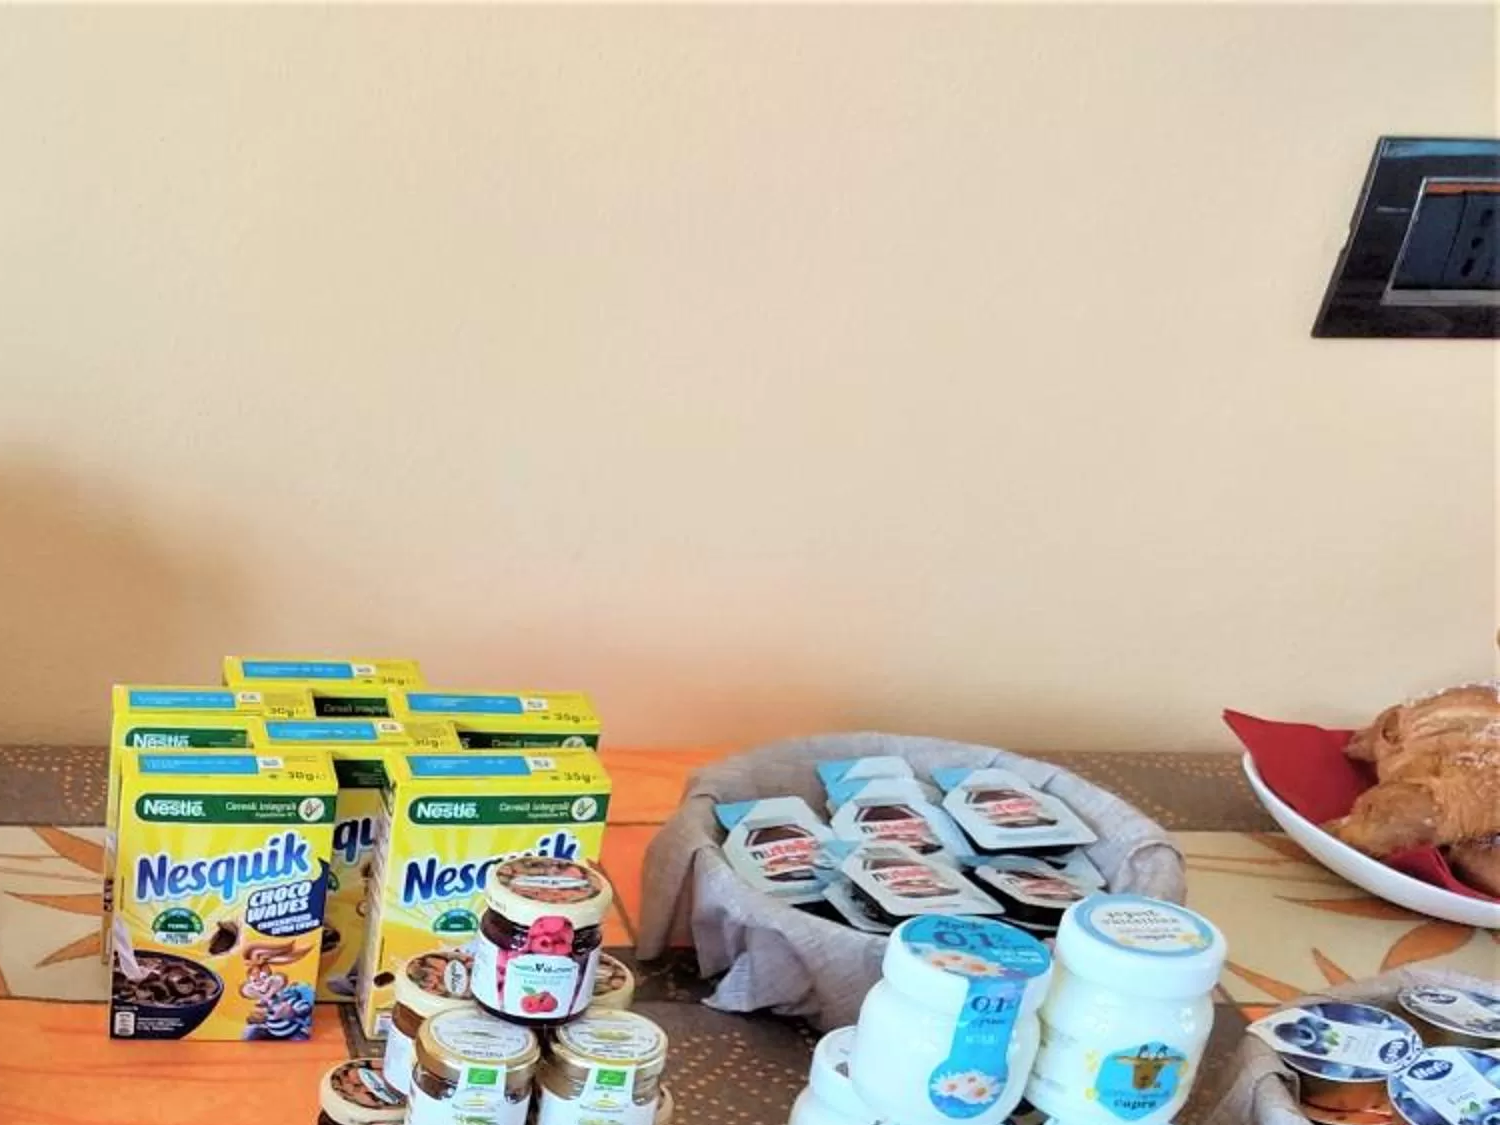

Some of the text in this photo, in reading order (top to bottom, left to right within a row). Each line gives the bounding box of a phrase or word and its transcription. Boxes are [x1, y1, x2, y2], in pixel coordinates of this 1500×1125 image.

[143, 799, 204, 817] Nestlé
[416, 802, 477, 819] Nestlé
[136, 831, 309, 900] Nesquik
[249, 881, 312, 907] CHOCO
[247, 896, 309, 923] WAVES
